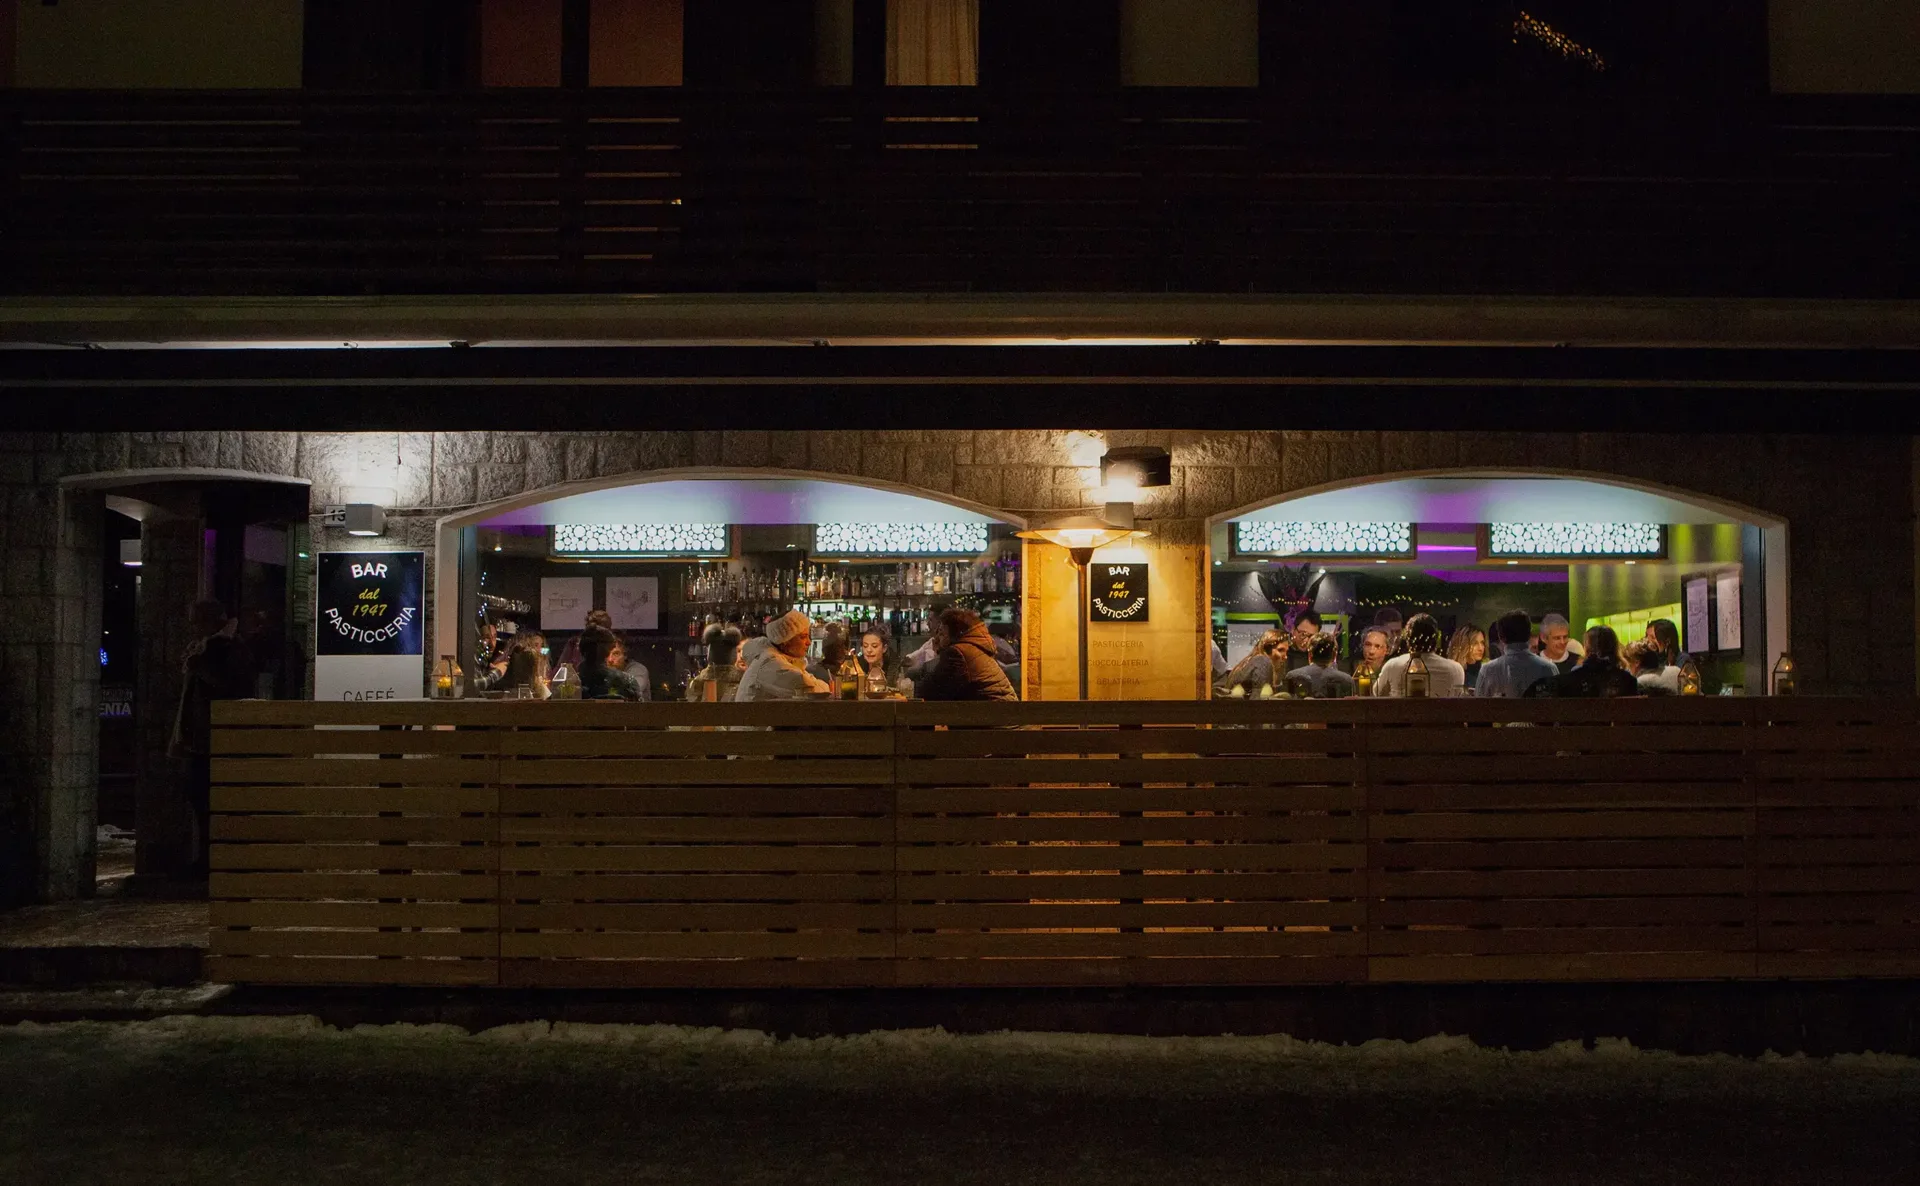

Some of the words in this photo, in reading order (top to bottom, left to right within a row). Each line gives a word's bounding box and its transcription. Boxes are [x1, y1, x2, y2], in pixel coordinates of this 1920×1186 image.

[351, 562, 388, 579] BAR
[1108, 565, 1131, 576] BAR
[1112, 581, 1126, 590] dal
[358, 588, 380, 600] dal
[1108, 590, 1130, 599] 1947
[352, 604, 388, 617] 1947
[1092, 597, 1146, 619] PASTICCERIA
[325, 606, 416, 643] PASTICCERIA
[1092, 640, 1145, 648] PASTICCERIA
[1096, 678, 1141, 686] GELATERIA
